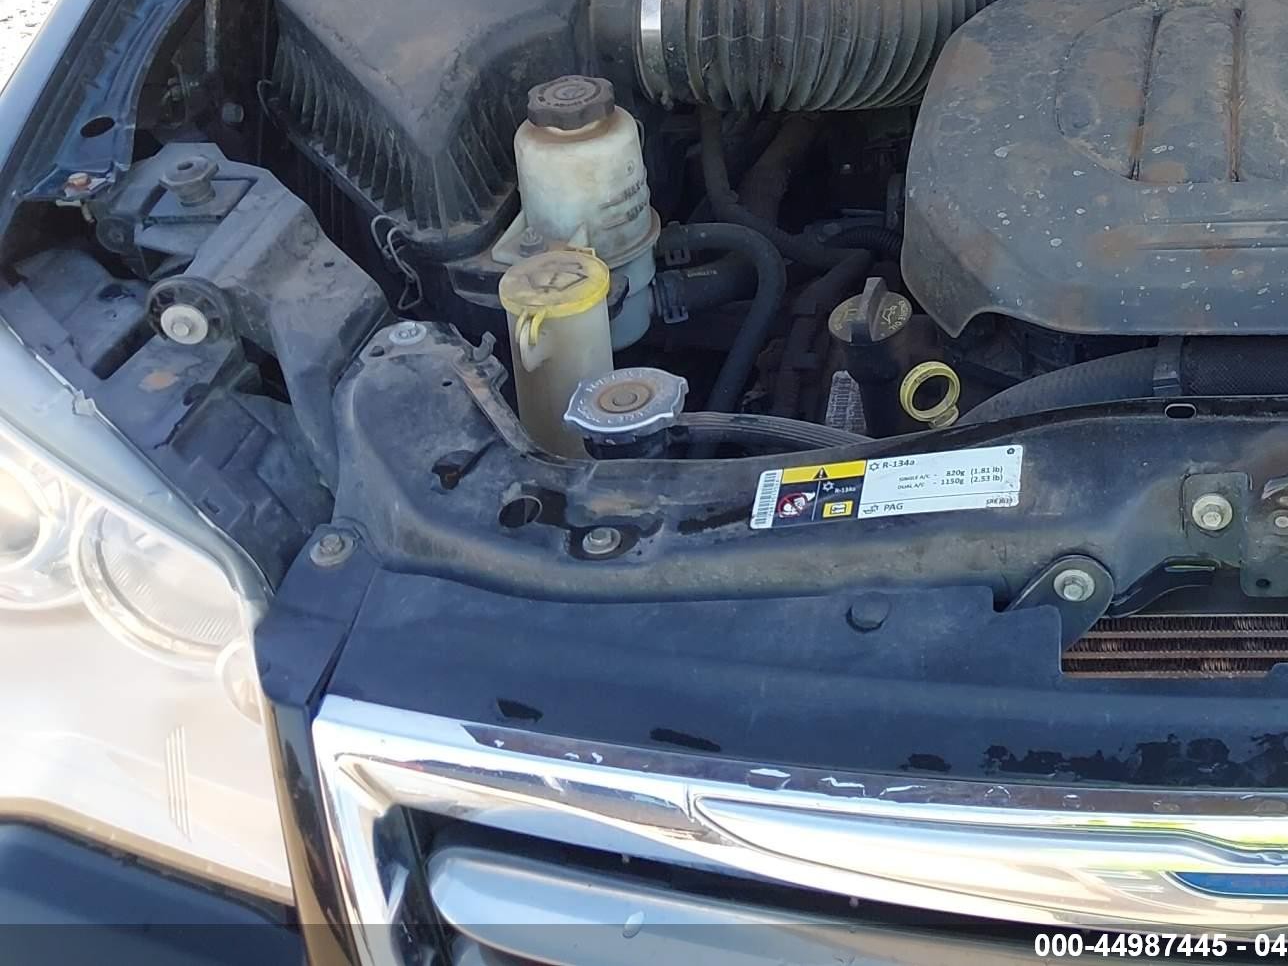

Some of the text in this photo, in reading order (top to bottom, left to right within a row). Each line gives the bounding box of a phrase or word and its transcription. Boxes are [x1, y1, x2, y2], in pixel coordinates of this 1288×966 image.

[882, 459, 915, 469] R-134a
[970, 467, 991, 476] (1.81
[992, 465, 1003, 474] lb)
[941, 477, 964, 486] 1150g
[970, 474, 991, 483] (2.53
[992, 473, 1003, 482] lb)
[883, 502, 904, 512] PAG
